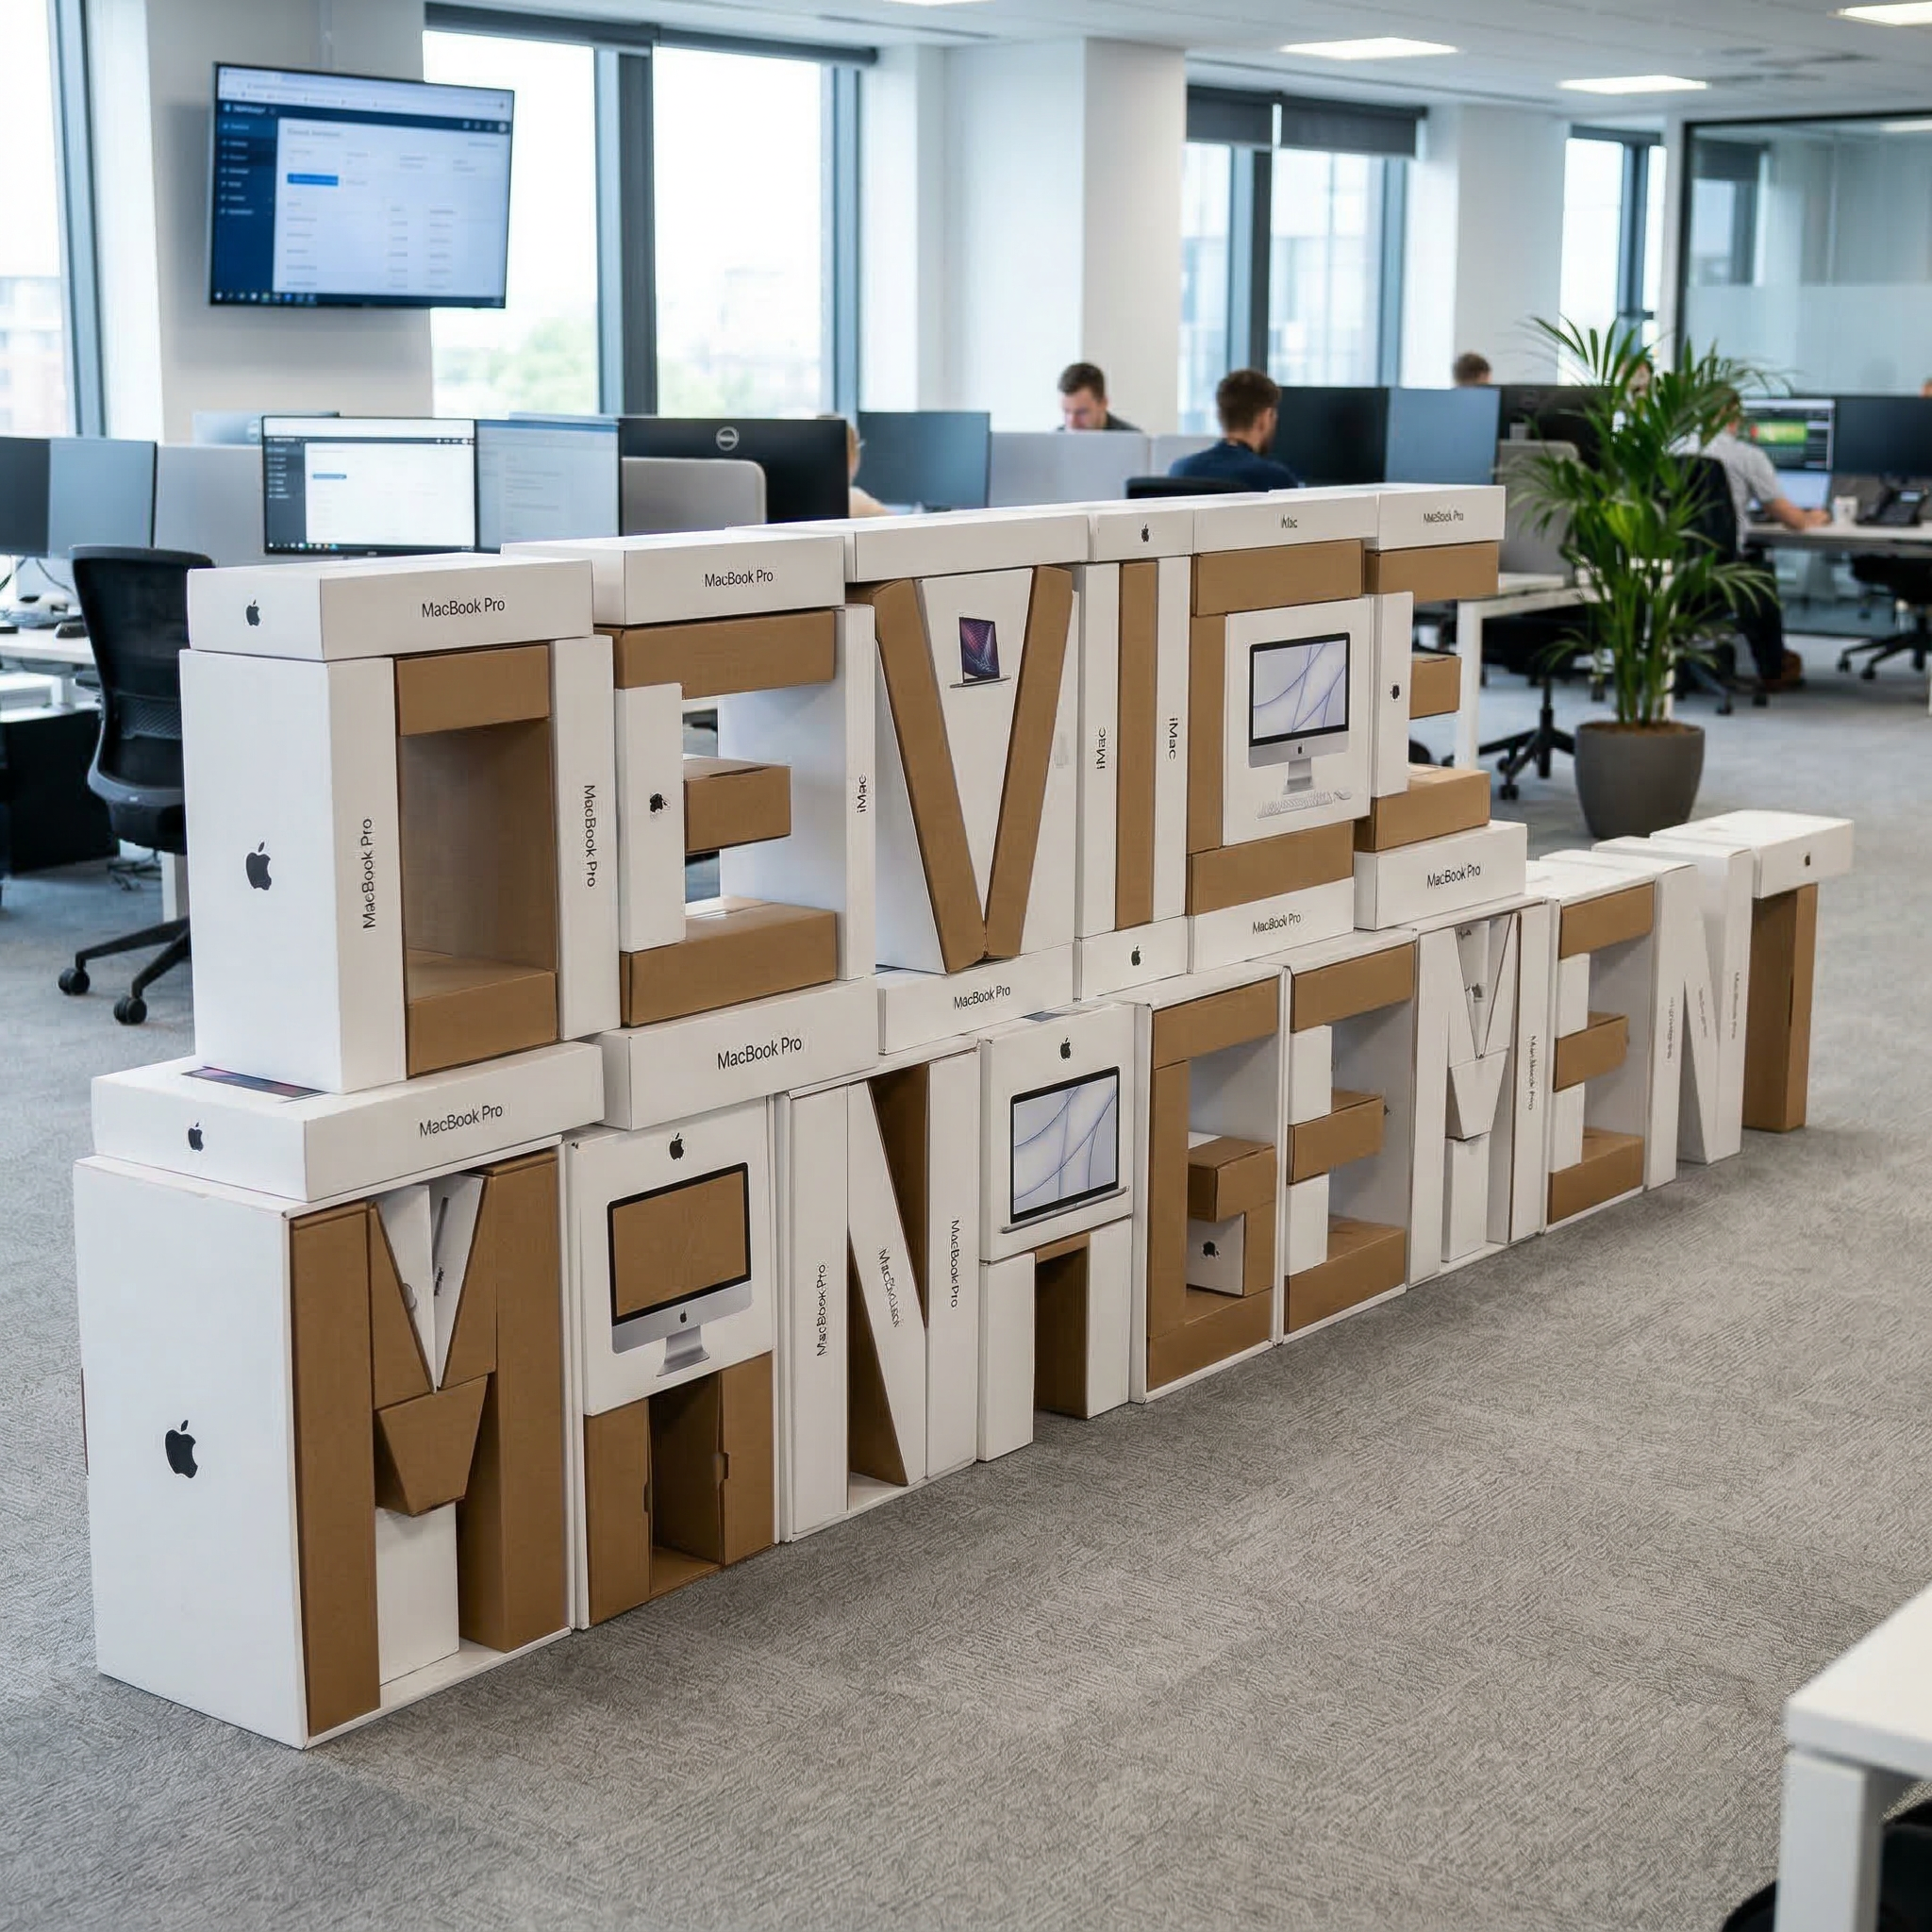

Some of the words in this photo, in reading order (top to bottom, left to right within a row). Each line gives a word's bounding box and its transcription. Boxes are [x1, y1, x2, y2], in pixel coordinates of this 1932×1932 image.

[705, 571, 754, 587] MacBook
[757, 570, 774, 582] Pro
[422, 598, 481, 618] MacBook
[485, 598, 506, 613] Pro
[1096, 727, 1107, 769] iMac
[1169, 718, 1179, 760] iMac
[857, 774, 868, 813] iMac
[360, 819, 374, 846] Pro
[584, 785, 598, 858] MacBook
[361, 850, 376, 928] MacBook
[587, 861, 598, 888] Pro
[1427, 867, 1466, 889] MacBook
[1467, 863, 1481, 878] Pro
[1289, 913, 1302, 926] Pro
[955, 988, 995, 1010] MacBook
[996, 986, 1011, 999] Pro
[718, 1040, 778, 1070] MacBook
[781, 1037, 803, 1056] Pro
[420, 1108, 479, 1138] MacBook
[482, 1106, 503, 1121] Pro
[950, 1219, 960, 1284] MacBook
[950, 1286, 960, 1308] Pro
